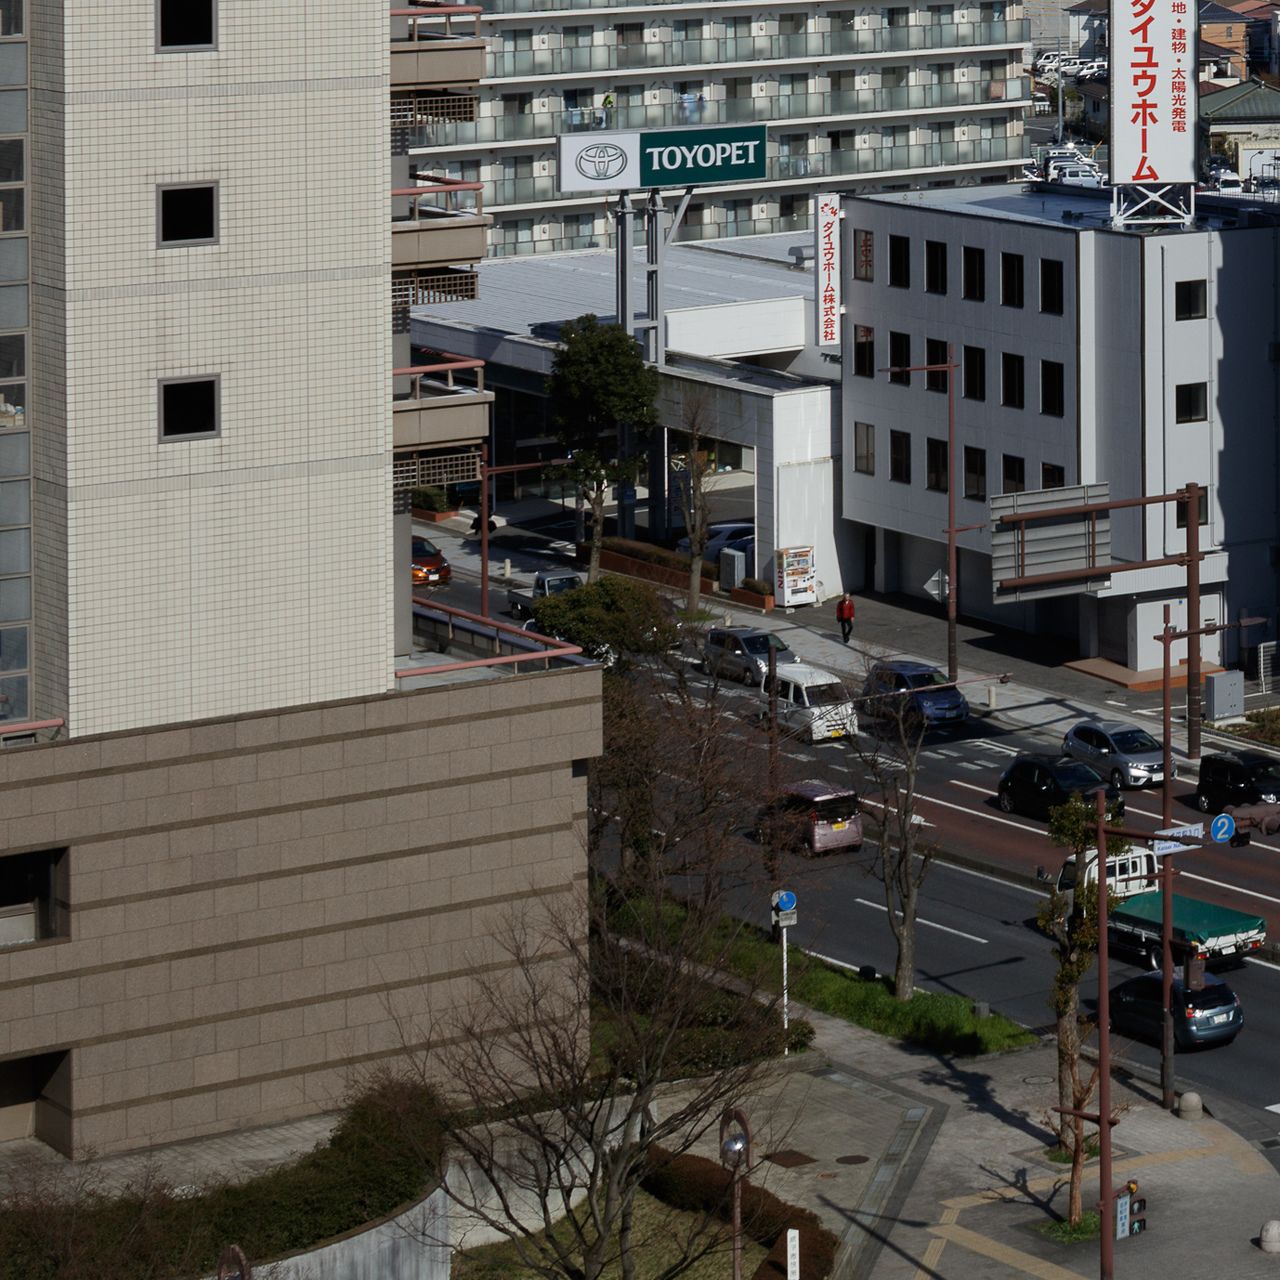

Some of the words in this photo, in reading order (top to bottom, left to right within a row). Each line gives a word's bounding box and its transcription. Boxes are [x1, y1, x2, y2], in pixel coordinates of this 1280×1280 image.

[645, 140, 760, 172] TOYOPET
[822, 220, 836, 341] ダイユウホーム株式会社
[1217, 817, 1229, 839] 2
